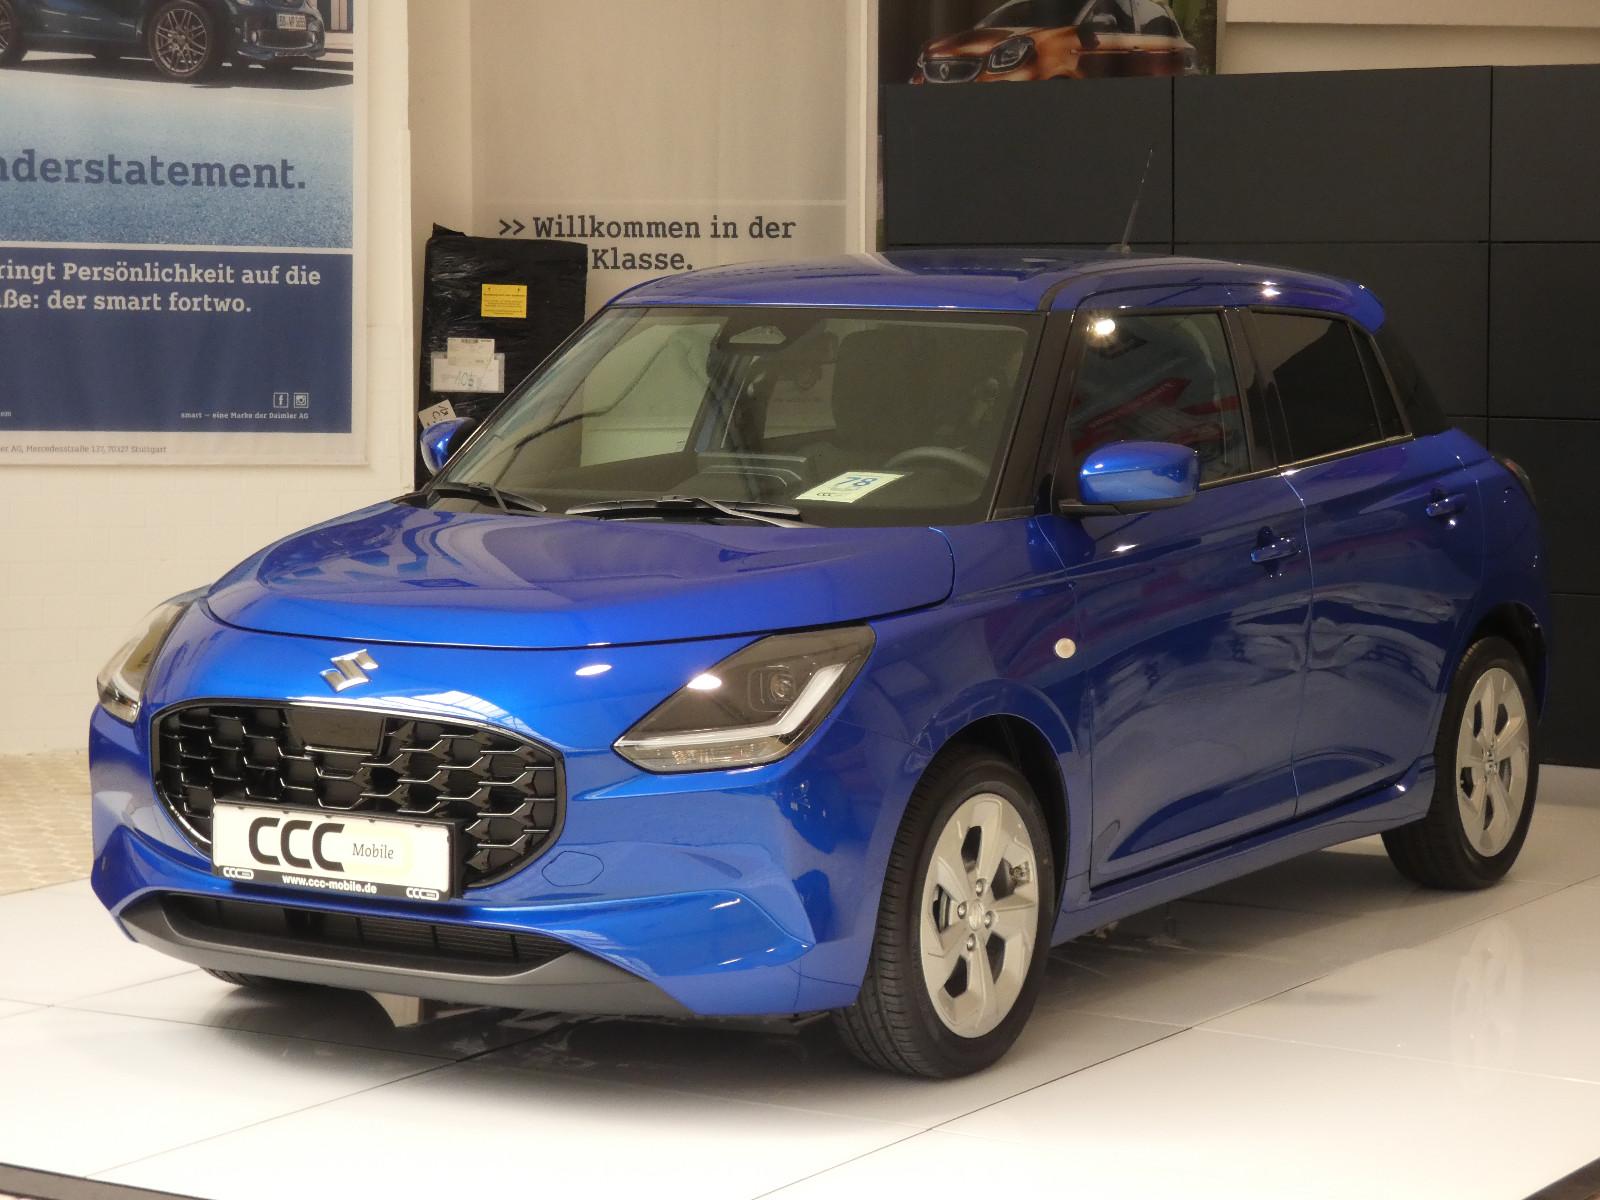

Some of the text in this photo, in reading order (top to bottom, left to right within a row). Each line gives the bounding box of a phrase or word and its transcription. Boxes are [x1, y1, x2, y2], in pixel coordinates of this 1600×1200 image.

[534, 215, 701, 239] Willkommen
[710, 216, 738, 239] in
[749, 216, 797, 239] der
[591, 248, 694, 271] Klasse.
[63, 261, 236, 284] Persönlichkeit
[242, 265, 281, 285] auf
[285, 266, 321, 285] die
[0, 289, 252, 312] ße: der smart fortwo.
[248, 816, 395, 873] CCC Mobile
[281, 873, 378, 895] www.ccc-mobile.de
